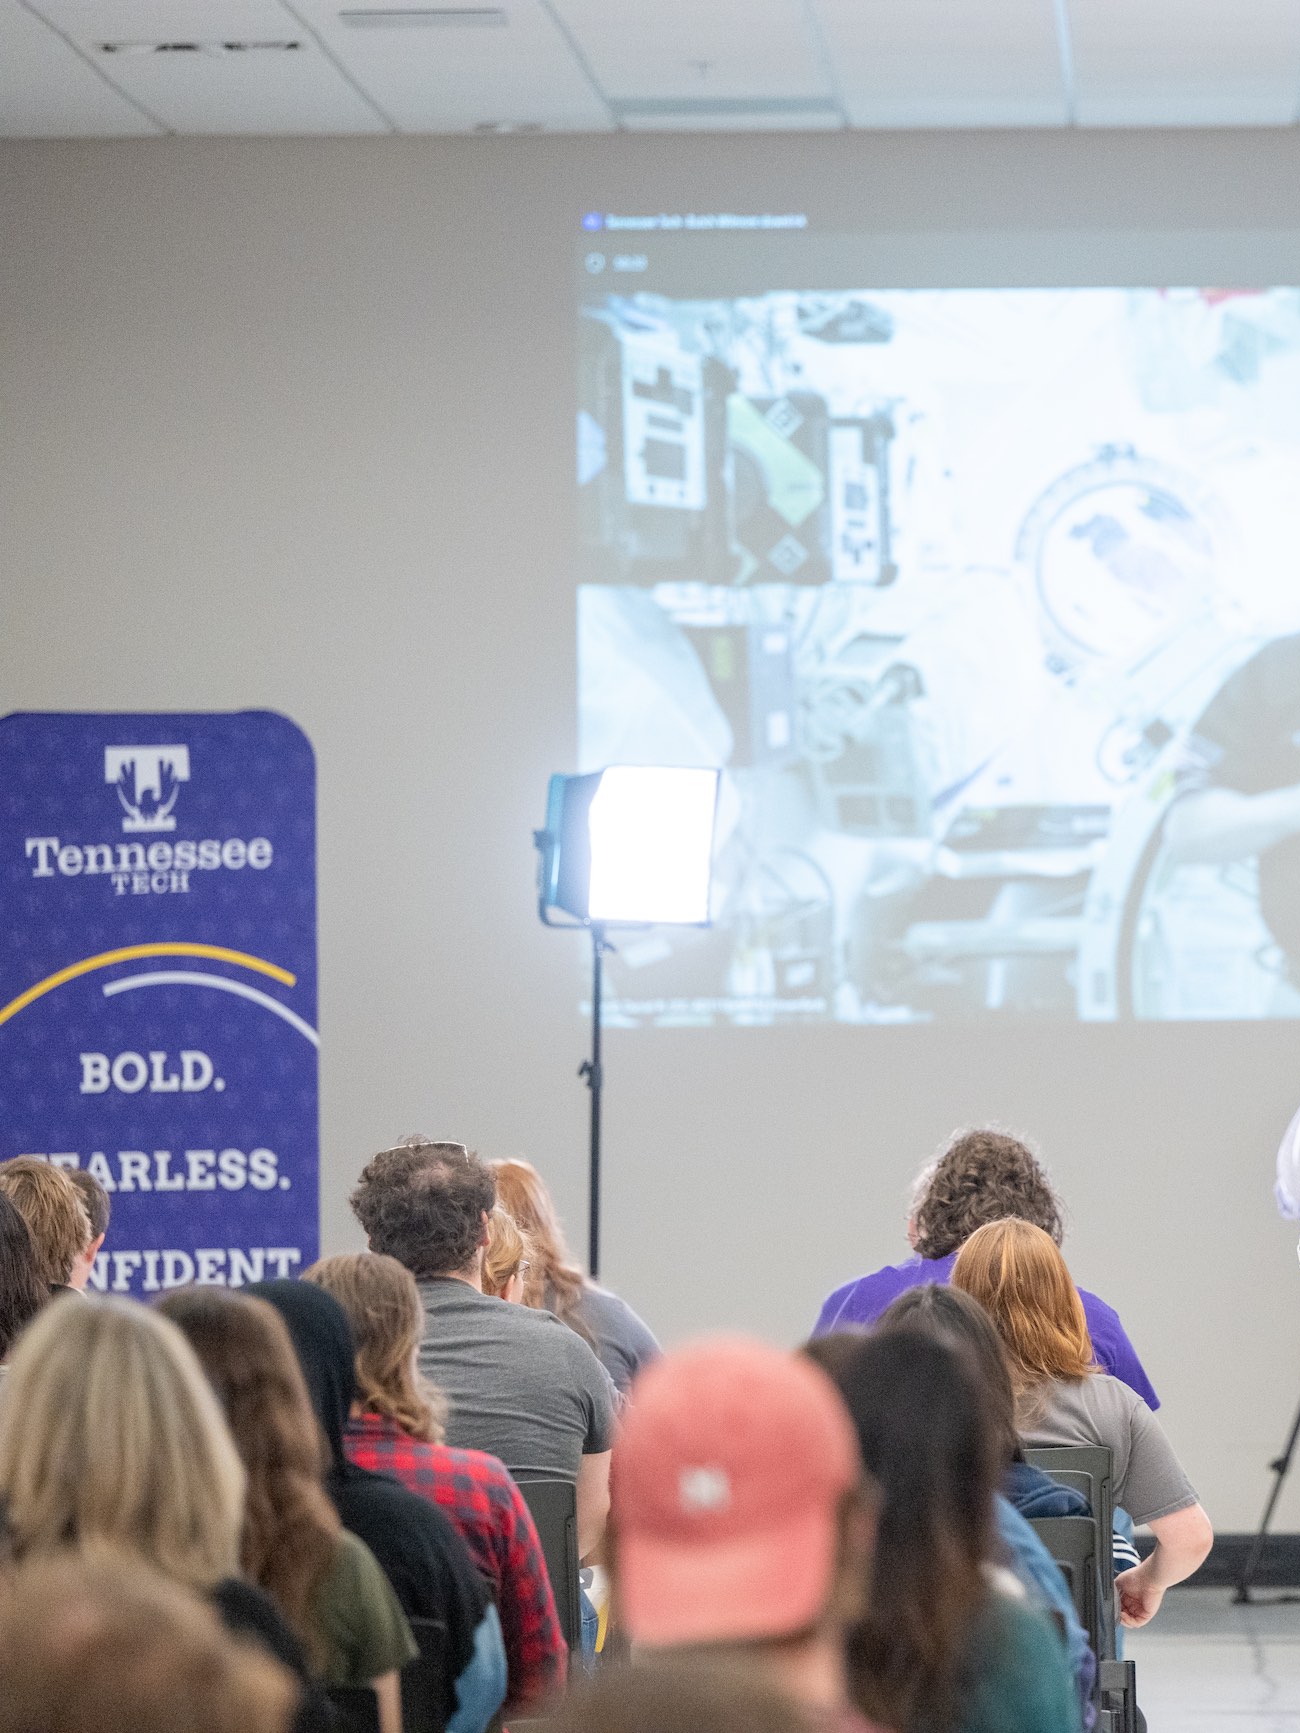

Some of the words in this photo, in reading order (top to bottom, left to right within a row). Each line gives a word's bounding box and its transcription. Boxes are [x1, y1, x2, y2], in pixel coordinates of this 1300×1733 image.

[25, 836, 274, 878] Tennessee
[111, 870, 190, 896] TECH
[79, 1050, 226, 1094] BOLD.
[18, 1148, 292, 1192] ARLESS.
[89, 1247, 301, 1291] NFIDENT
